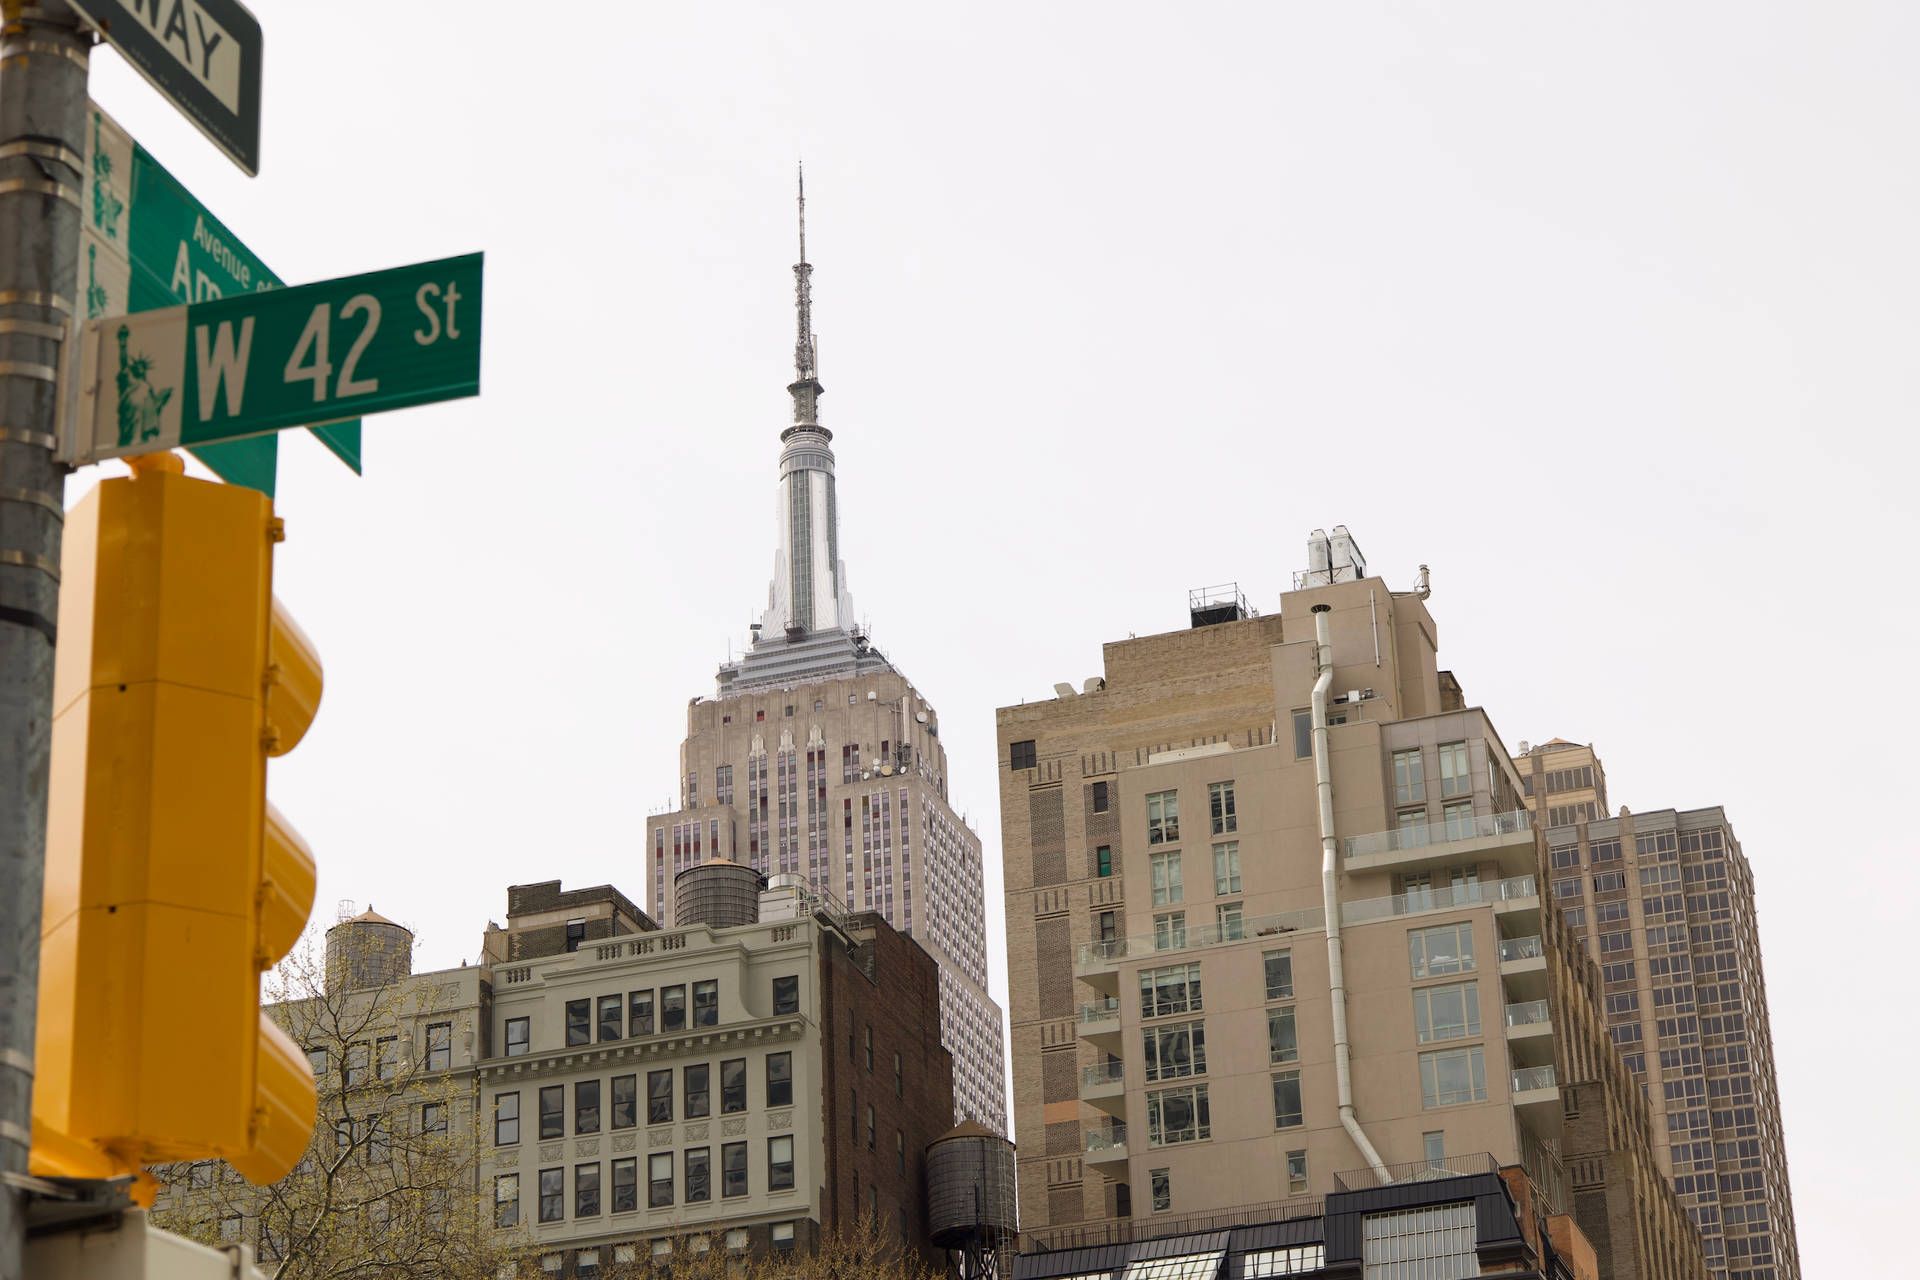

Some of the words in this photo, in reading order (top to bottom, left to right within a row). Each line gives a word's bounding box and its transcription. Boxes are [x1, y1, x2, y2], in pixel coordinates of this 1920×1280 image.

[193, 214, 251, 290] Avenue
[195, 316, 256, 422] W
[283, 294, 382, 402] 42
[414, 281, 462, 346] St
